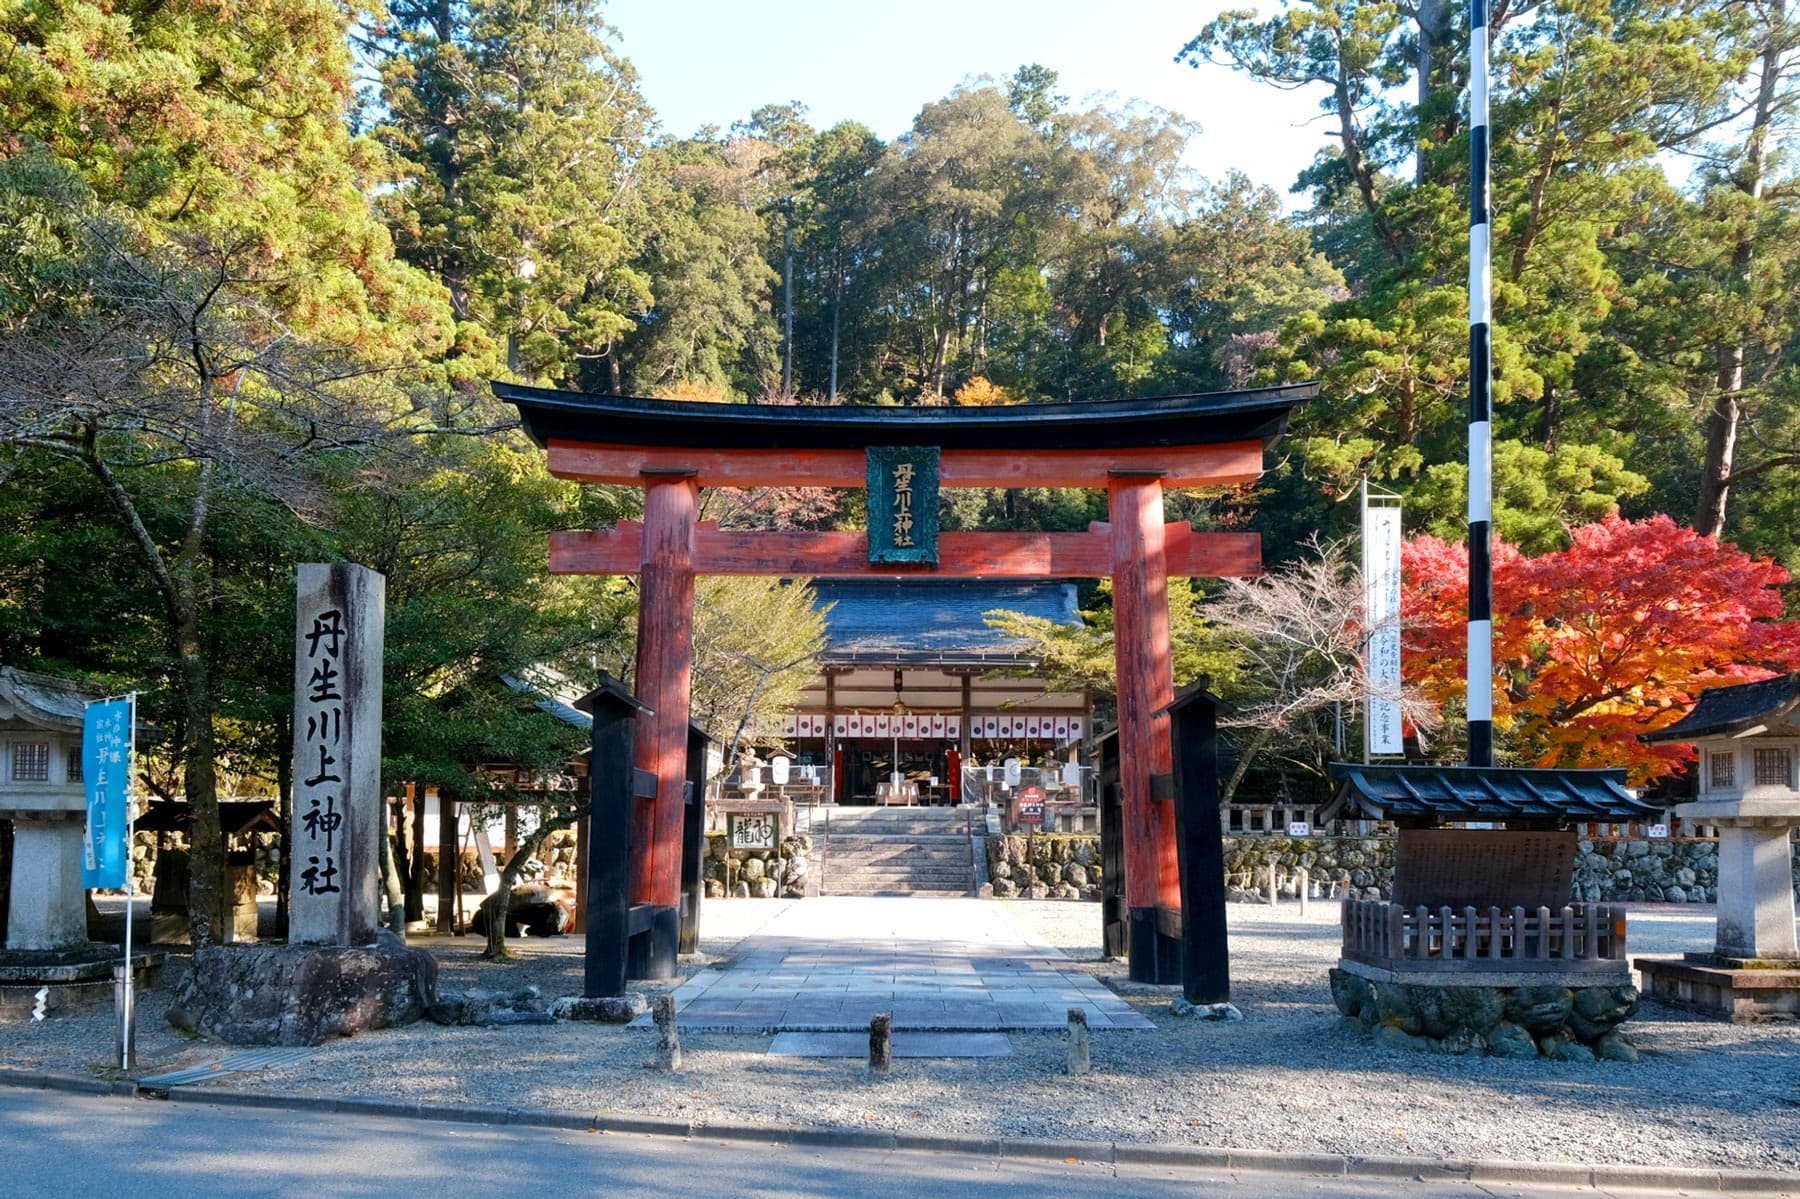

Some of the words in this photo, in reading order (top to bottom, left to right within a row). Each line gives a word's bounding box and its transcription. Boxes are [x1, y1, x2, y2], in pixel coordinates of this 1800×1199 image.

[893, 463, 916, 547] 丹生川上神社
[94, 747, 109, 868] 丹生川上
[300, 610, 346, 895] 丹生川上神社
